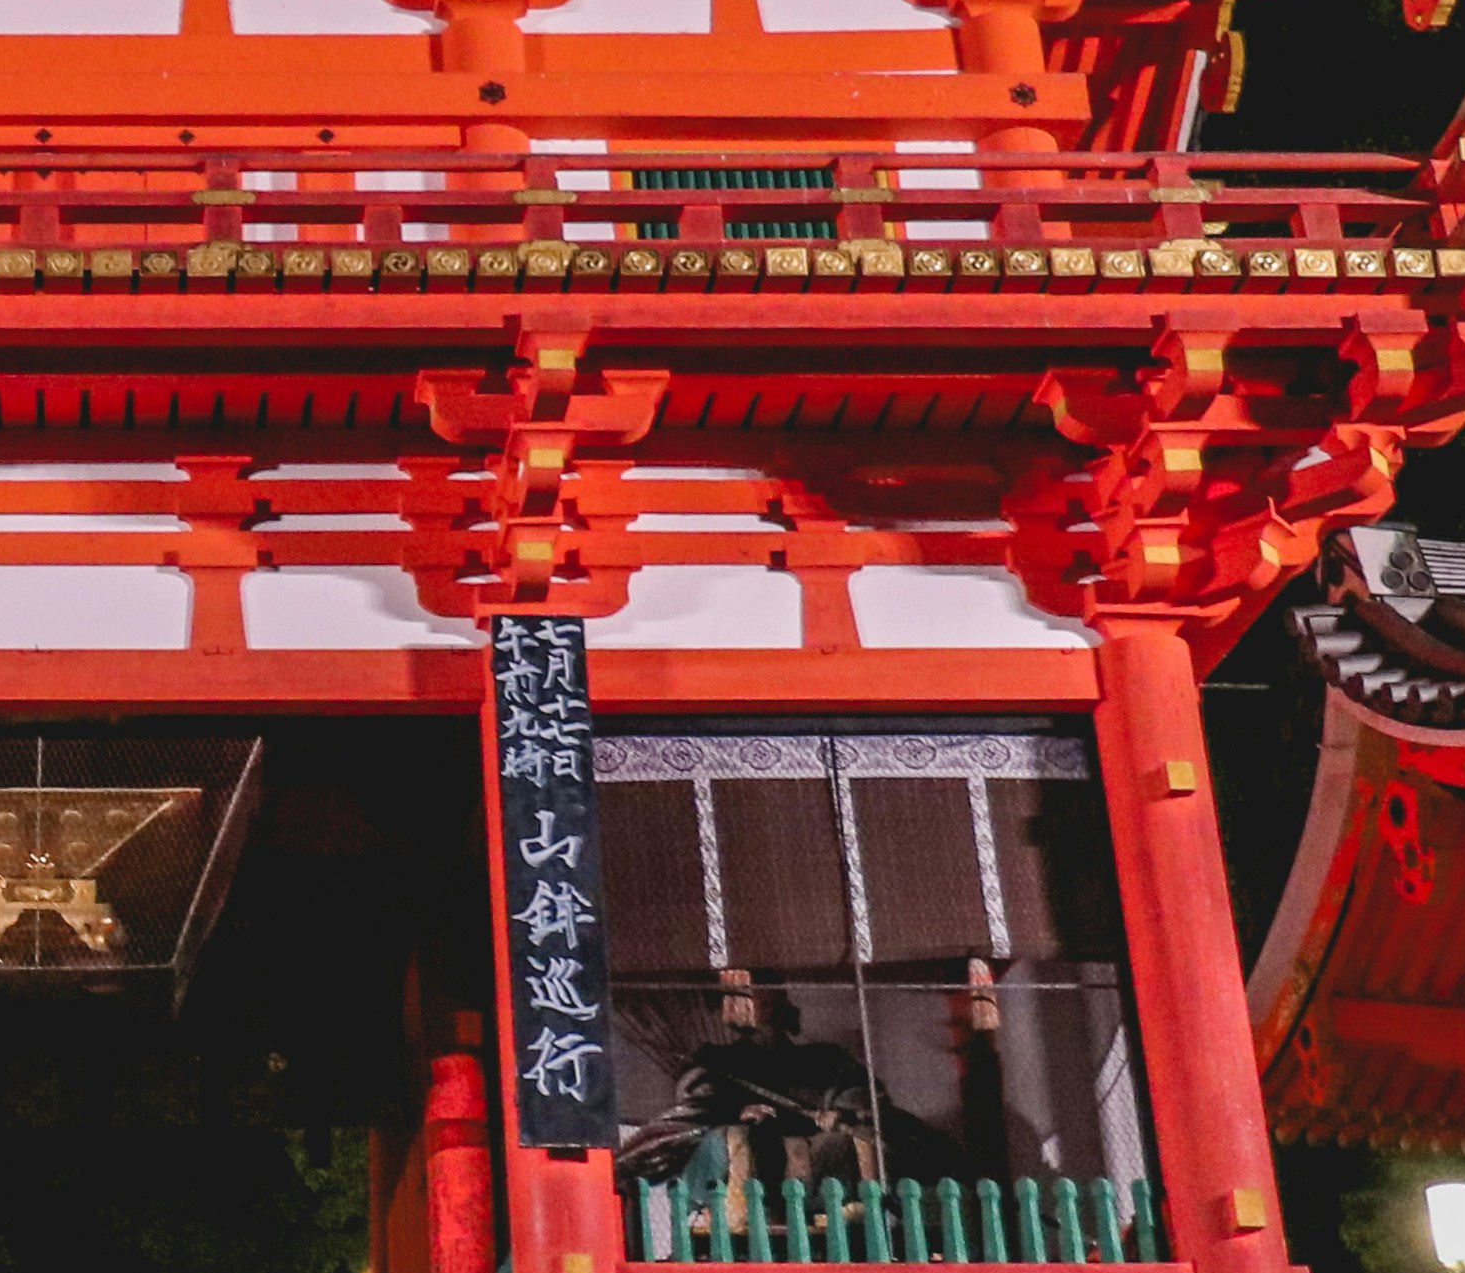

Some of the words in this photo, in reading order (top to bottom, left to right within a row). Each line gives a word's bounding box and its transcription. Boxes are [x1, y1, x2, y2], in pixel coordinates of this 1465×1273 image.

[494, 616, 551, 789] 午前九時
[533, 619, 591, 782] 七月十七日
[512, 810, 603, 1103] 山鉾巡行
